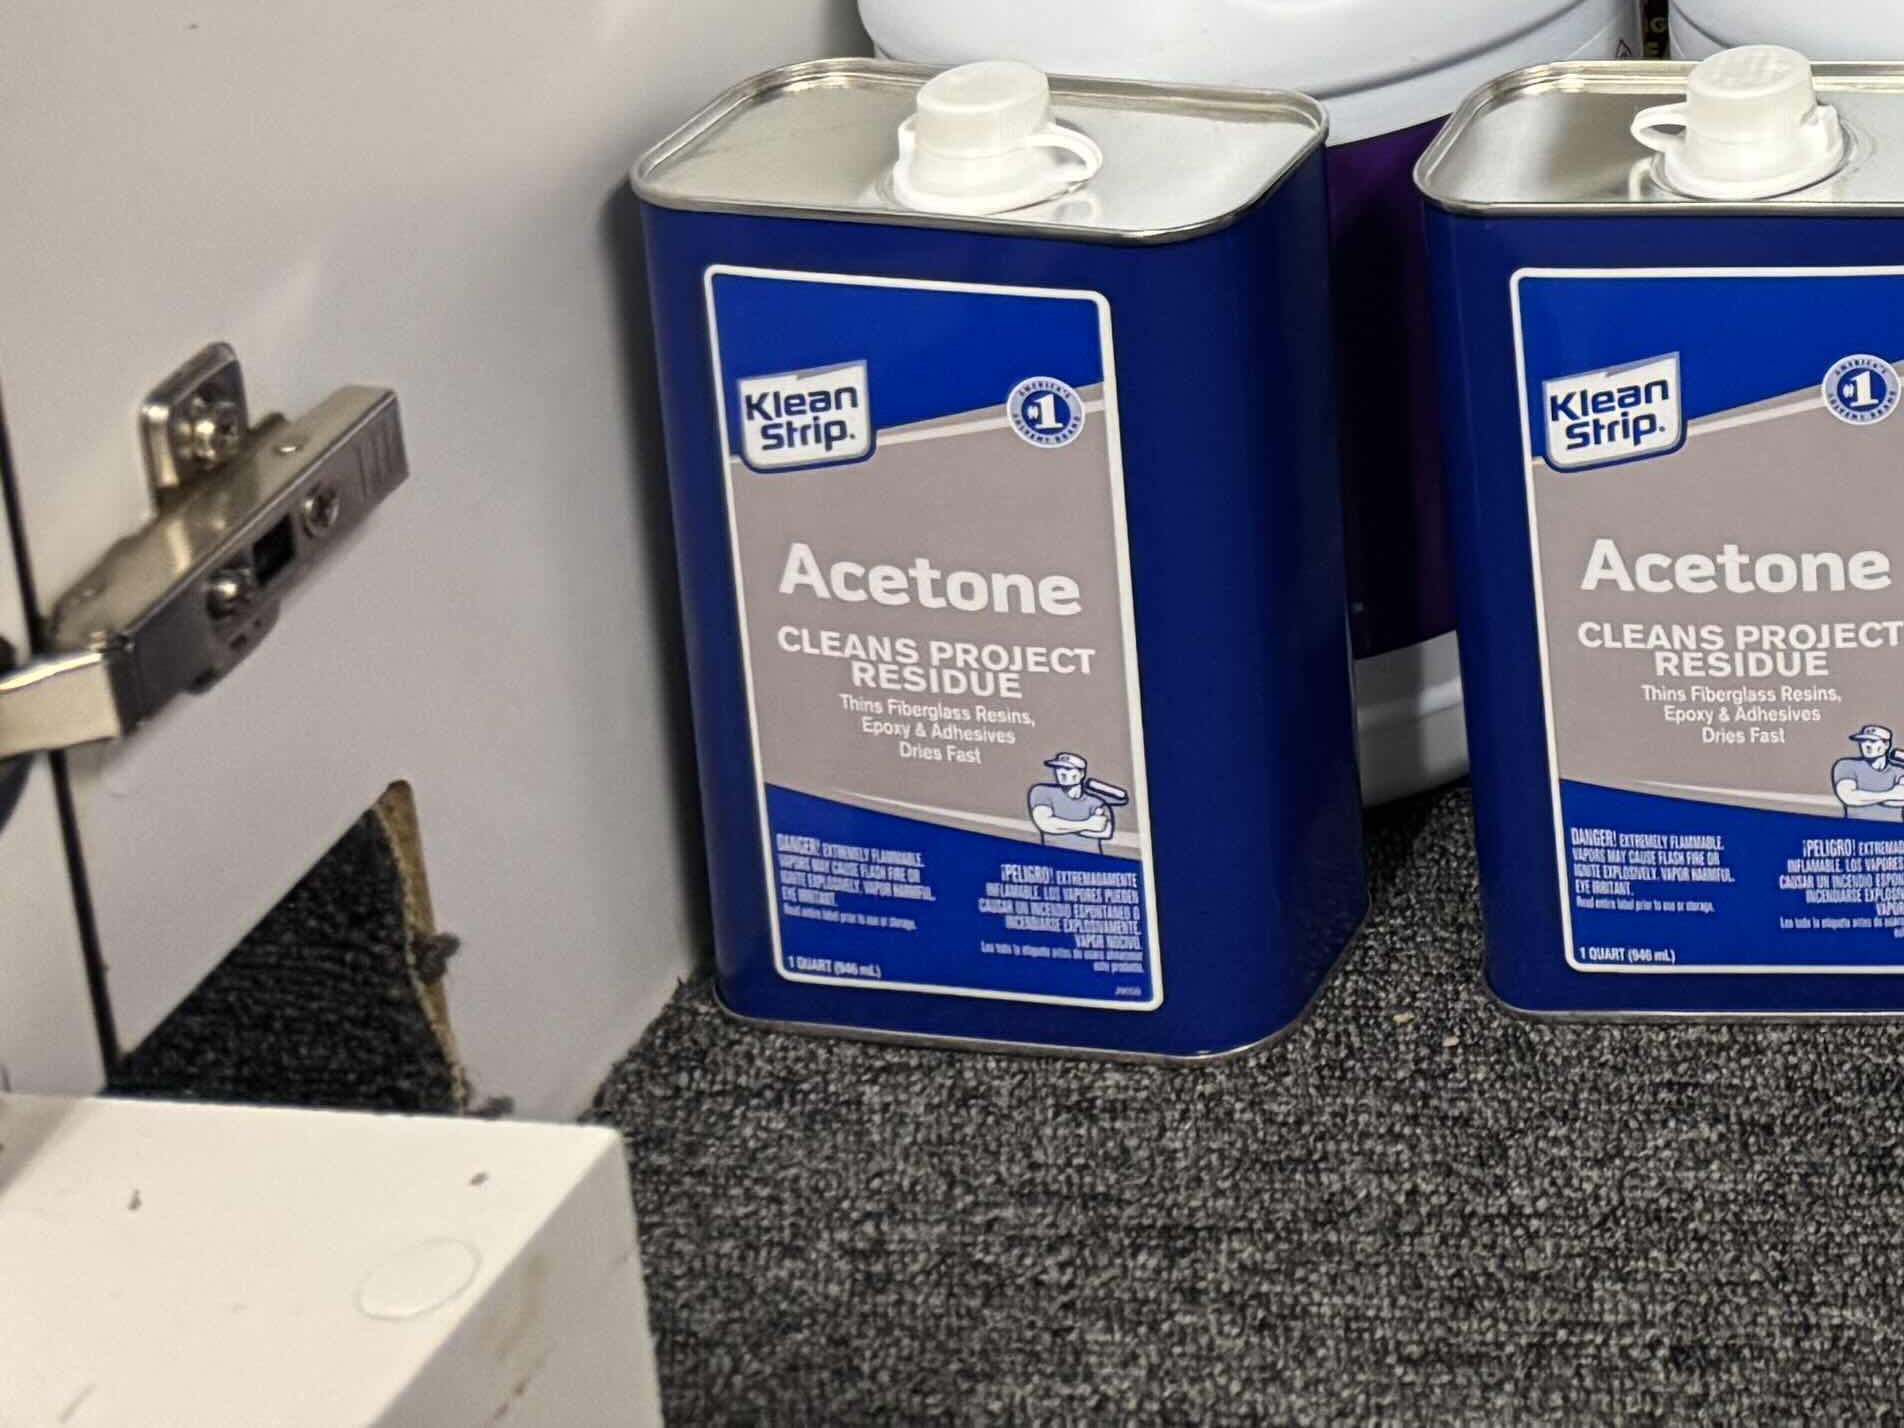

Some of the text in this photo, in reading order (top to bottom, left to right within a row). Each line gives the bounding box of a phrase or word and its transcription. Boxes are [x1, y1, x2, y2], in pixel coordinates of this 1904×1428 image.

[745, 386, 858, 423] Klean
[1550, 379, 1669, 422] Klean
[778, 542, 1082, 616] Acetone
[1581, 538, 1892, 594] Acetone
[778, 626, 1095, 674] CLEANS PROJECT
[1578, 621, 1904, 651] CLEANS PROJECT
[852, 662, 1022, 699] RESIDUE
[1654, 651, 1828, 678] RESIDUE
[1641, 684, 1842, 705] Thins Fiberglass Resins,
[1664, 705, 1821, 725] Epoxy & Adhesives
[1702, 727, 1785, 745] Dries Fast
